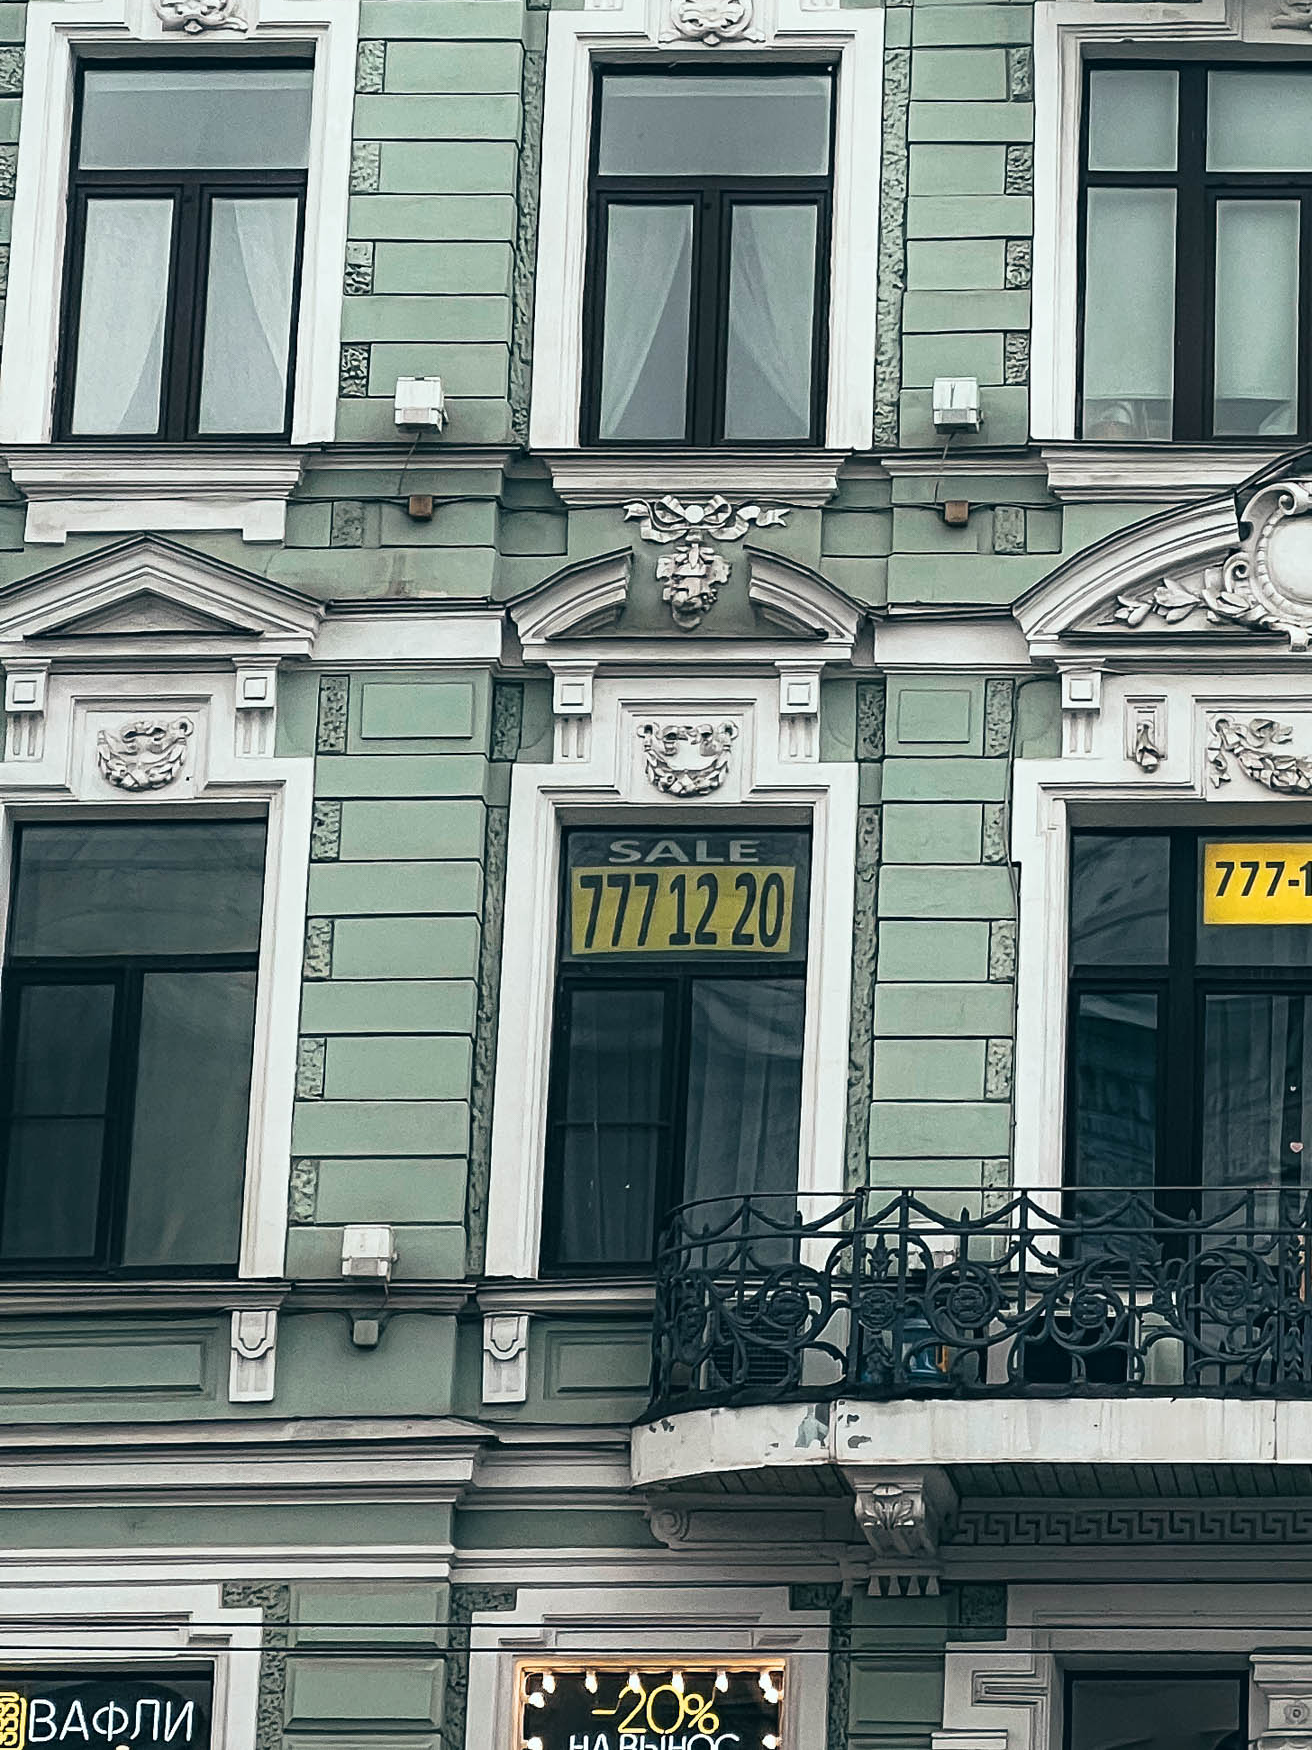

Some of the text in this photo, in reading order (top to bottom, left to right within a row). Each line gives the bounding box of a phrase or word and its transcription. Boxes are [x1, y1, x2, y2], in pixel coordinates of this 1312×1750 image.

[608, 840, 761, 863] SALE
[28, 1699, 194, 1742] ВАФЛИ
[592, 1684, 720, 1734] -20%
